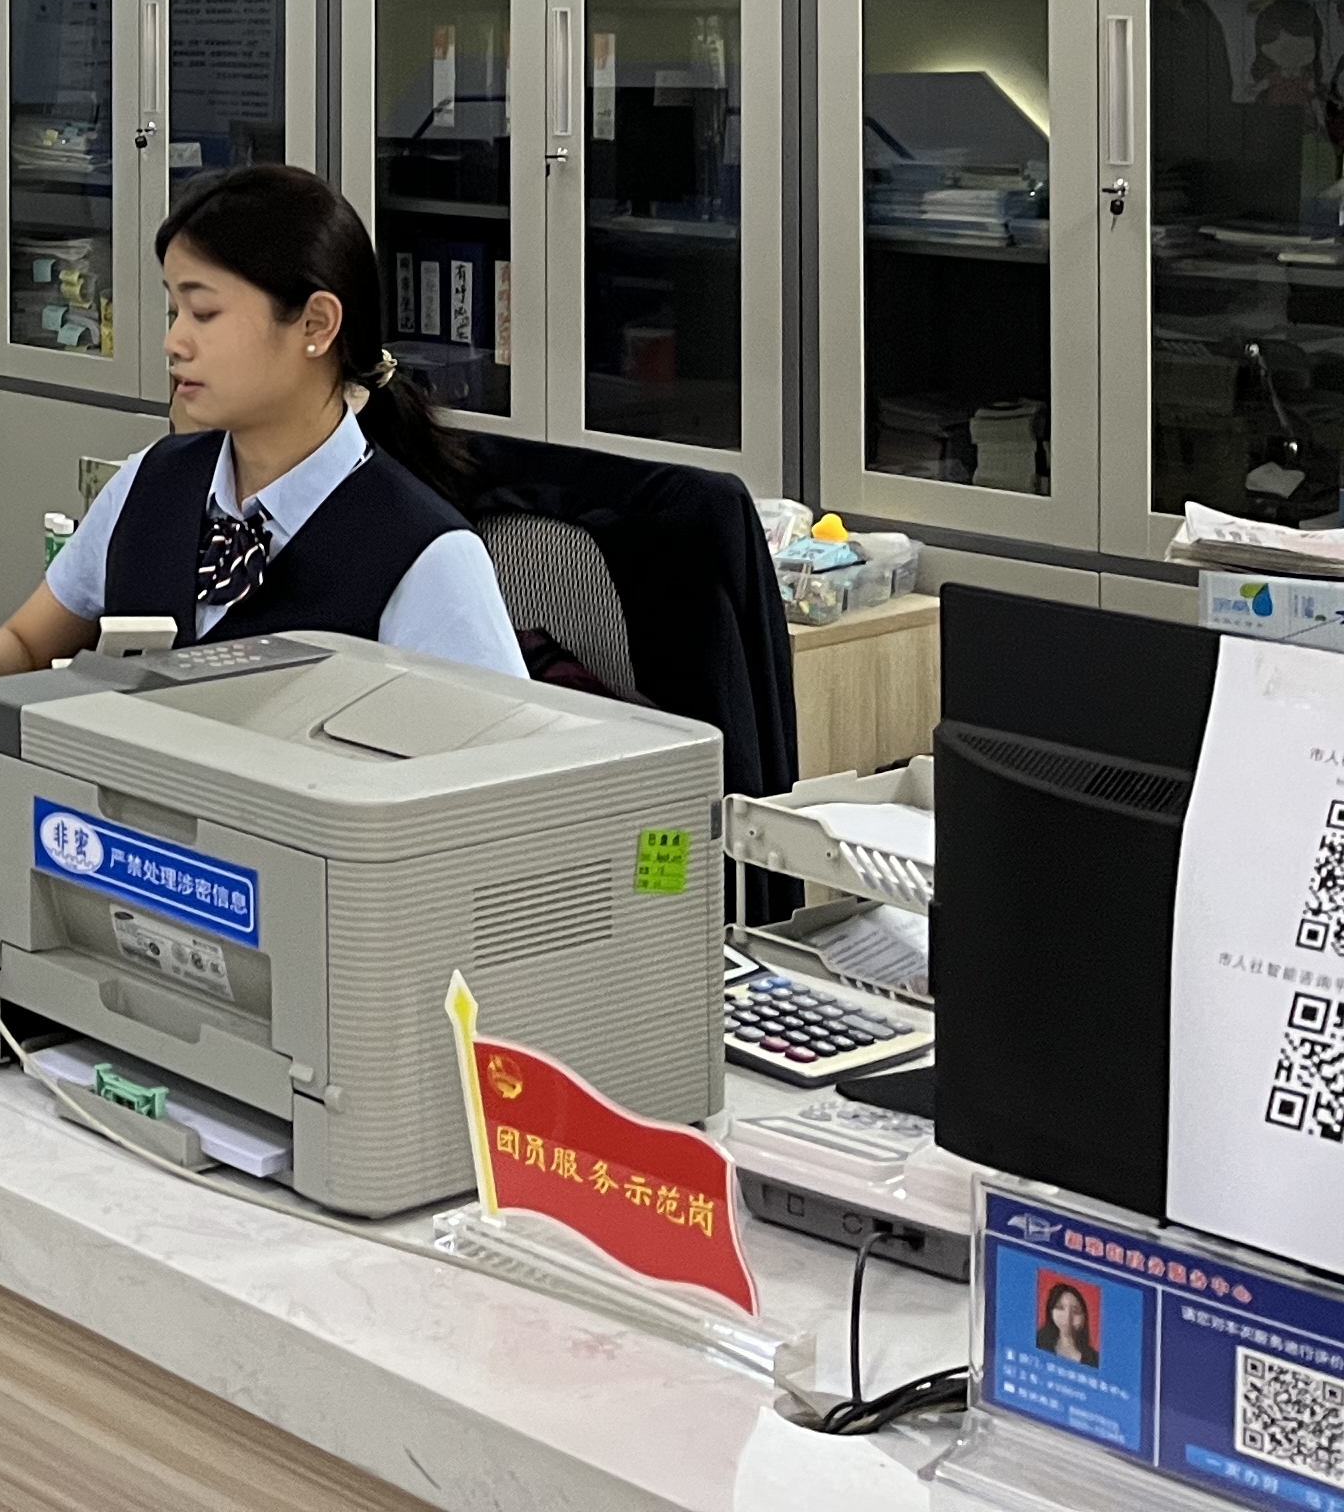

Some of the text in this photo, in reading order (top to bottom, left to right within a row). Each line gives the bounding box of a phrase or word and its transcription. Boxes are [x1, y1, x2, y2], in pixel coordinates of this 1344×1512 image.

[1309, 747, 1344, 767] 市人
[53, 820, 90, 857] 非密
[109, 847, 249, 916] 严禁处理涉密信息
[496, 1124, 715, 1238] 团员服务示范岗
